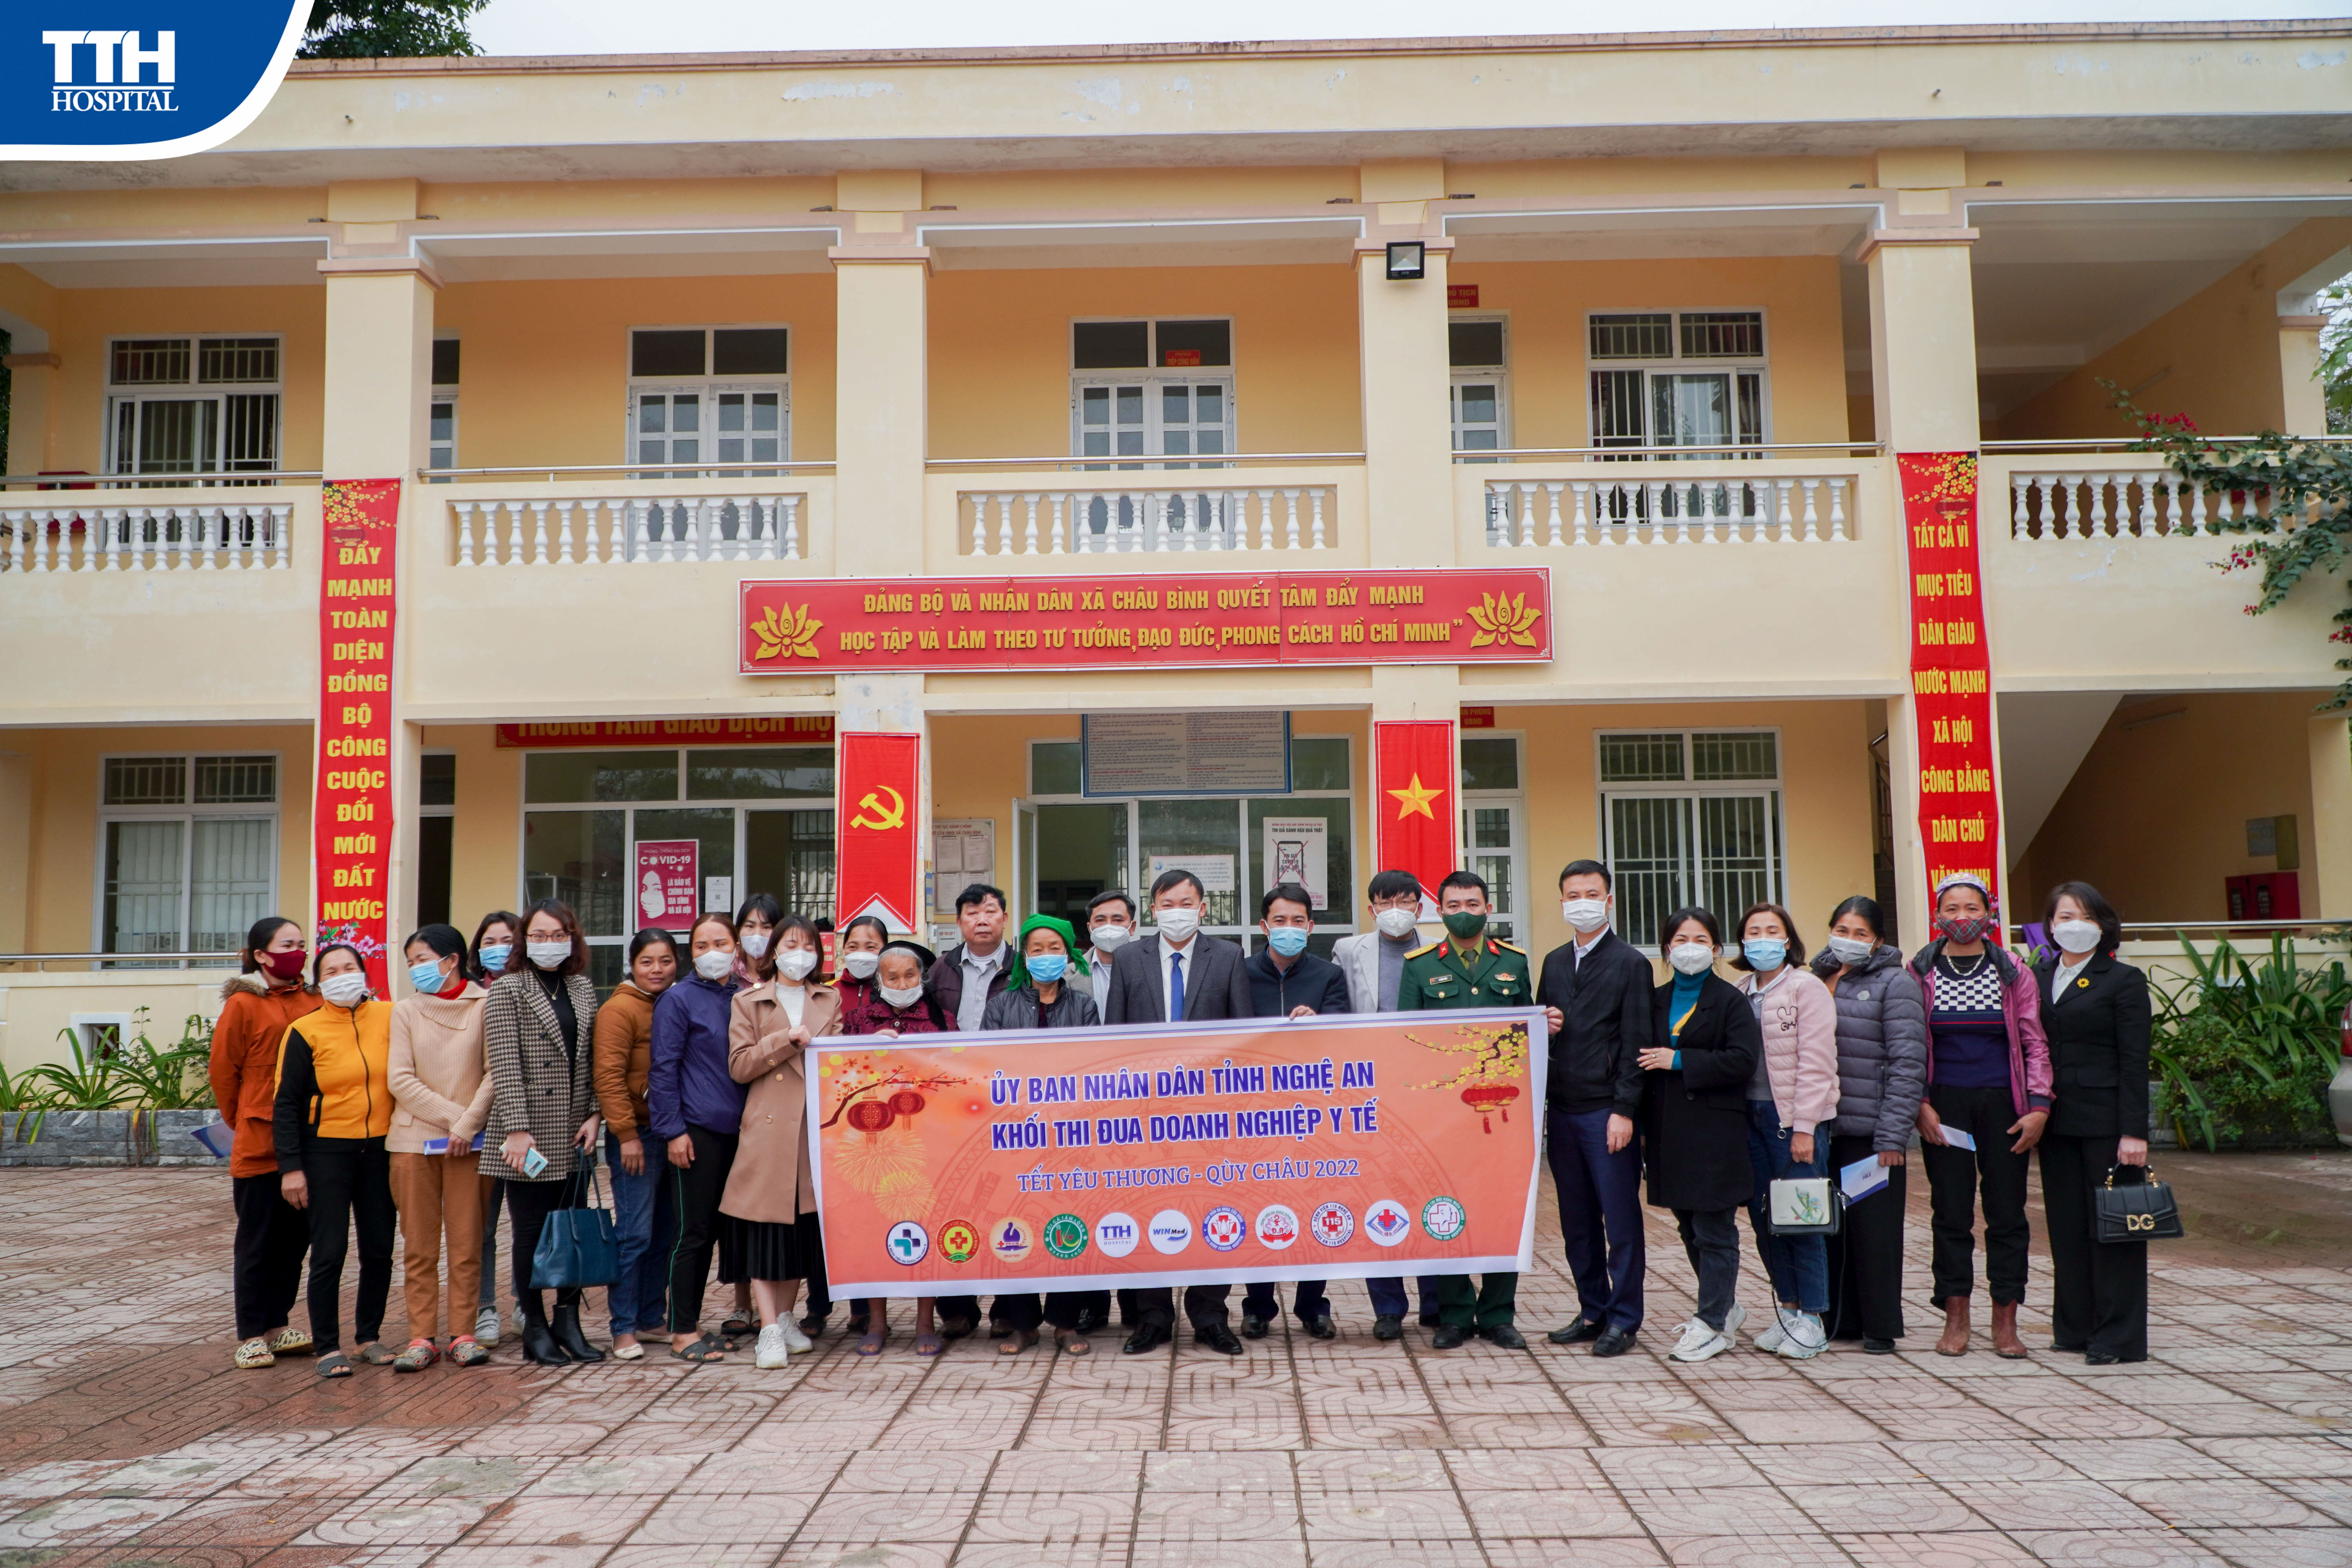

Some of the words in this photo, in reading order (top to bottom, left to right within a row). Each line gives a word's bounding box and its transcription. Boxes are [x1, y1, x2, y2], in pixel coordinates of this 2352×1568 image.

[1913, 518, 1935, 548] TẤT
[1938, 518, 1955, 548] CẢ
[1957, 520, 1969, 547] VÌ
[339, 541, 381, 565] ĐẨY
[327, 579, 392, 600] MẠNH
[864, 587, 913, 613] ĐẢNG
[920, 588, 944, 616] BỘ
[951, 588, 971, 612] VÀ
[980, 588, 1029, 612] NHÂN
[1038, 588, 1073, 611] DÂN
[1081, 587, 1105, 610] XÃ
[1112, 586, 1158, 610] CHÂU
[1166, 586, 1209, 609] BÌNH
[1217, 581, 1271, 610] QUYẾT
[1280, 584, 1317, 607] TÂM
[1326, 577, 1358, 607] ĐẨY
[1370, 586, 1424, 609] MẠNH
[1916, 573, 1944, 601] MỤC
[1946, 568, 1972, 596] TIÊU
[330, 607, 387, 629] TOÀN
[840, 631, 875, 654] HỌC
[881, 627, 913, 653] TẬP
[919, 626, 940, 650] VÀ
[947, 626, 985, 649] LÀM
[994, 630, 1037, 648] THEO
[1043, 627, 1066, 648] TƯ
[1289, 620, 1333, 644] CÁCH
[1341, 617, 1364, 643] HỒ
[1370, 619, 1397, 643] CHÍ
[1919, 618, 1944, 645] DÂN
[1947, 618, 1975, 644] GIÀU
[333, 639, 384, 664] DIỆN
[328, 669, 388, 693] ĐỒNG
[1914, 667, 1947, 694] NƯỚC
[1949, 670, 1986, 698] MẠNH
[342, 703, 372, 728] BỘ
[663, 719, 720, 734] GIAO
[728, 717, 785, 738] DỊCH
[1933, 716, 1949, 743] XÃ
[1952, 715, 1973, 748] HỘI
[327, 736, 387, 757] CÔNG
[327, 768, 385, 793] CUỘC
[1921, 766, 1954, 793] CÔNG
[1957, 761, 1990, 792] BẰNG
[336, 797, 374, 822] ĐỔI
[1932, 815, 1957, 842] DÂN
[1960, 811, 1985, 842] CHỦ
[334, 833, 376, 855] MỚI
[640, 856, 691, 865] COVID-19
[333, 863, 375, 887] ĐẤT
[323, 896, 384, 920] NƯỚC
[991, 1071, 1021, 1106] ỦY
[1027, 1076, 1077, 1104] BAN
[1083, 1067, 1150, 1102] NHÂN
[1156, 1065, 1205, 1097] DÂN
[1211, 1060, 1265, 1095] TỈNH
[1271, 1057, 1334, 1096] NGHỆ
[1341, 1061, 1375, 1089] AN
[991, 1112, 1047, 1150] KHỐI
[1053, 1120, 1091, 1148] THI
[1096, 1117, 1144, 1145] ĐUA
[1149, 1112, 1230, 1143] DOANH
[1236, 1103, 1322, 1141] NGHIỆP
[1328, 1107, 1344, 1134] Y
[1349, 1097, 1378, 1133] TẾ
[1016, 1164, 1054, 1192] TẾT
[1058, 1167, 1098, 1191] YÊU
[1102, 1167, 1190, 1188] THƯƠNG
[1252, 1156, 1310, 1181] CHÂU
[1314, 1159, 1360, 1178] 2022
[1101, 1225, 1131, 1238] TTH
[2126, 1214, 2155, 1230] DG
